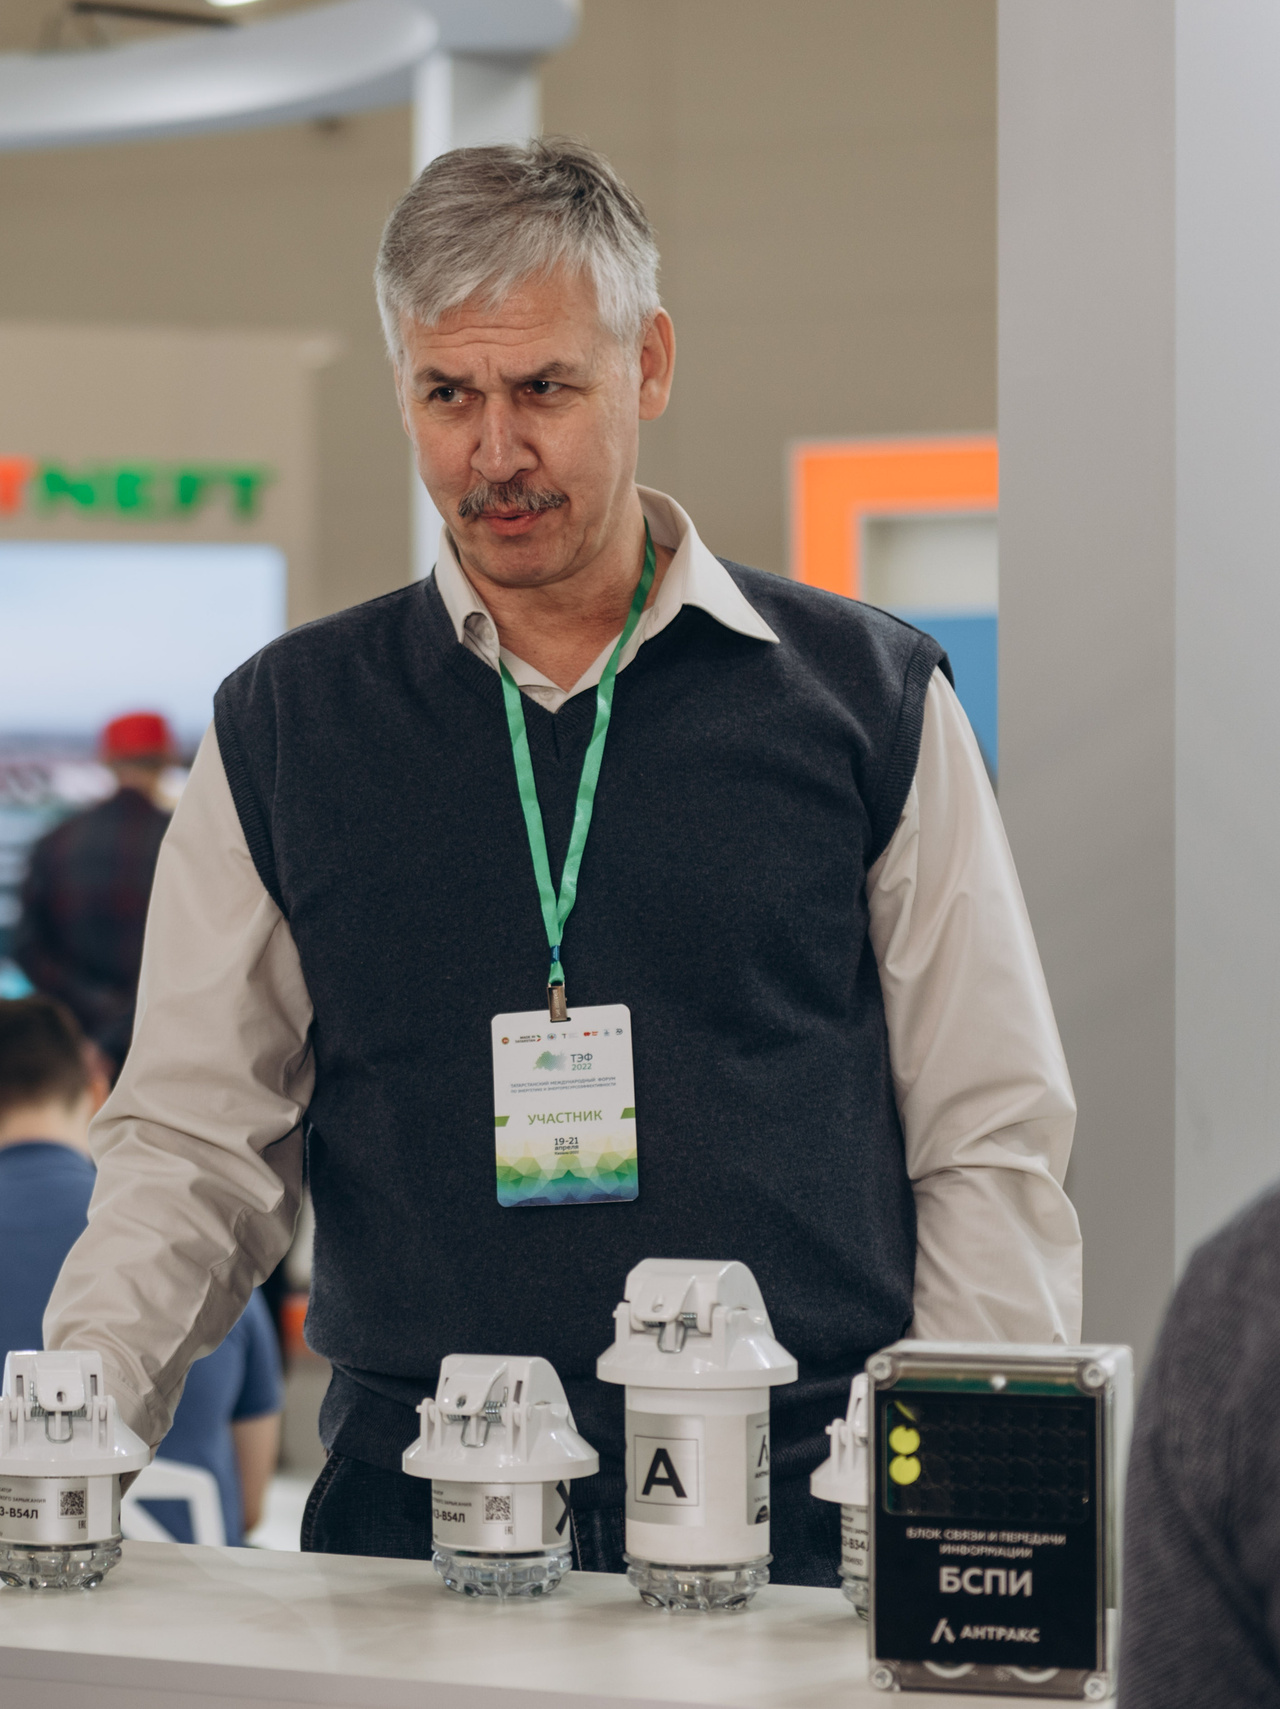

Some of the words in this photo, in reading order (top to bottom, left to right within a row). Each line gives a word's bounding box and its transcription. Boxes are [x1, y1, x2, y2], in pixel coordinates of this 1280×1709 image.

[570, 1052, 593, 1063] ТЭФ
[571, 1062, 593, 1071] 2022
[527, 1110, 602, 1125] УЧАСТНИК
[554, 1137, 579, 1146] 19-21
[906, 1526, 942, 1540] БЛОК
[943, 1528, 986, 1542] СВЯЗИ
[987, 1531, 998, 1542] И
[999, 1531, 1067, 1546] ПЕРЕДАЧИ
[939, 1543, 1033, 1559] ИНФОРМАЦИИ
[938, 1565, 1033, 1598] БСПИ
[959, 1624, 1041, 1644] АНТРАКС
